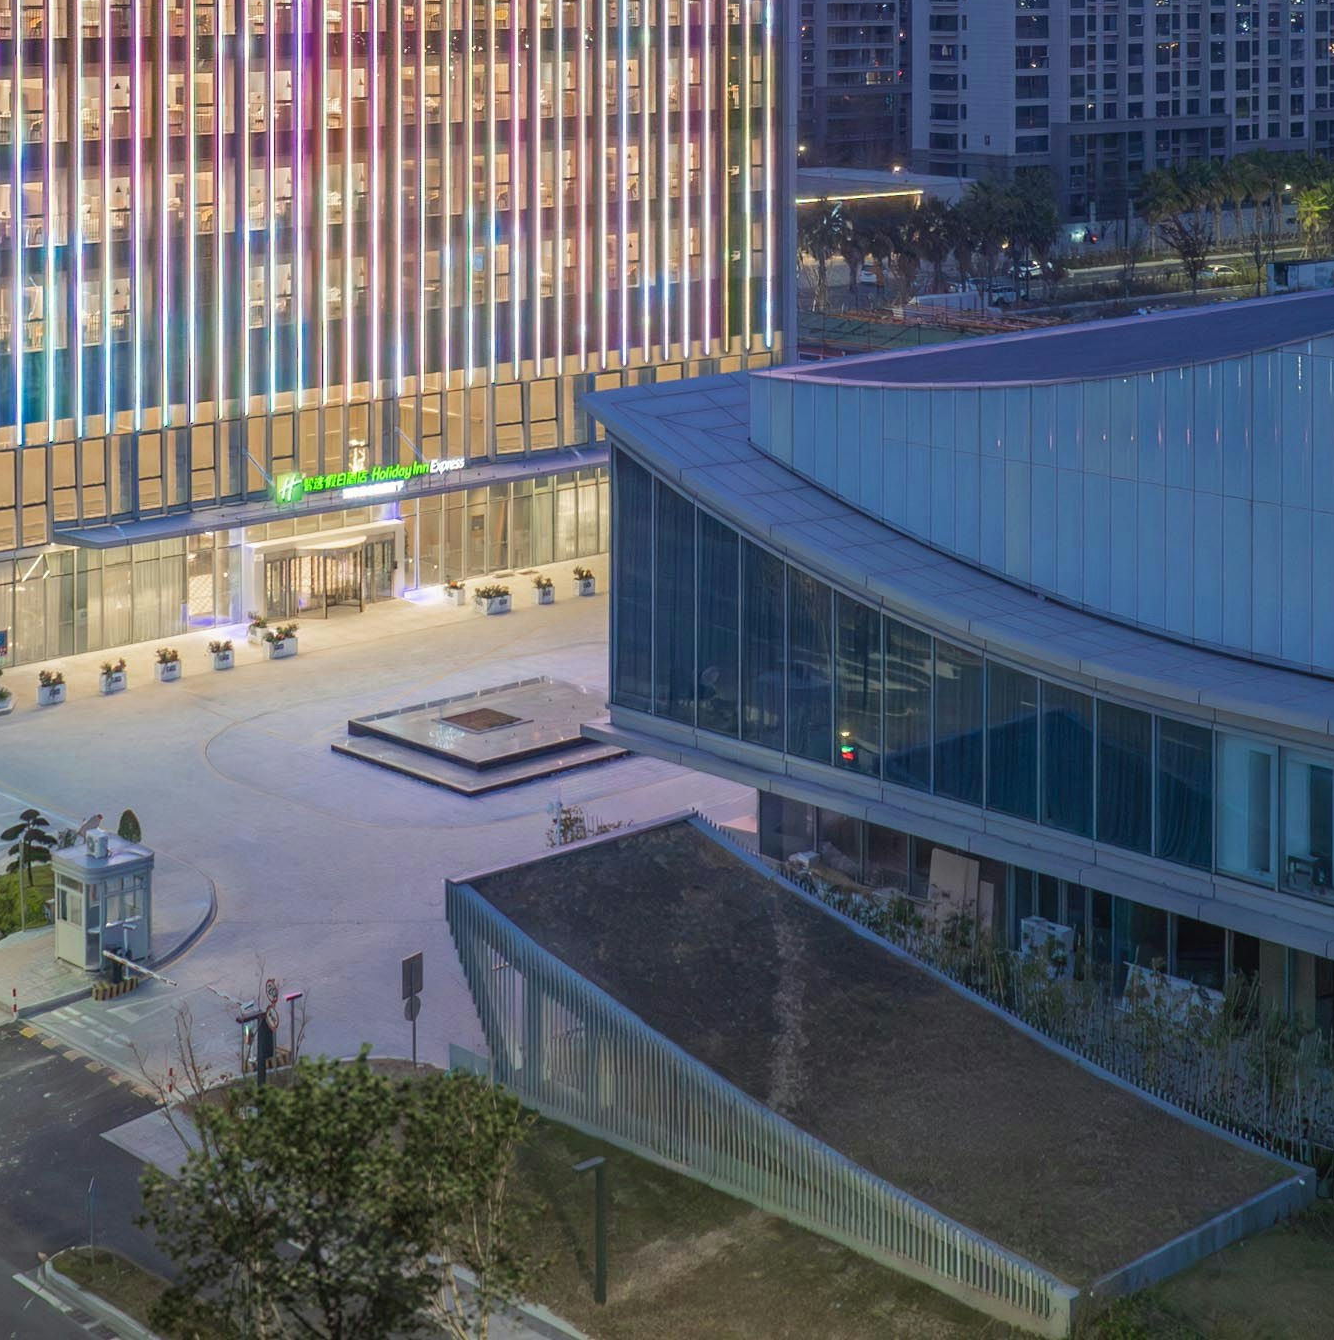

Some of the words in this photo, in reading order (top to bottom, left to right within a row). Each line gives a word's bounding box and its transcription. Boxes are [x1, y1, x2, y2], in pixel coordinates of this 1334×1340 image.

[304, 469, 367, 492] 智选假日酒店
[372, 463, 413, 482] Holiday
[413, 461, 429, 475] Inn
[429, 457, 465, 474] Express
